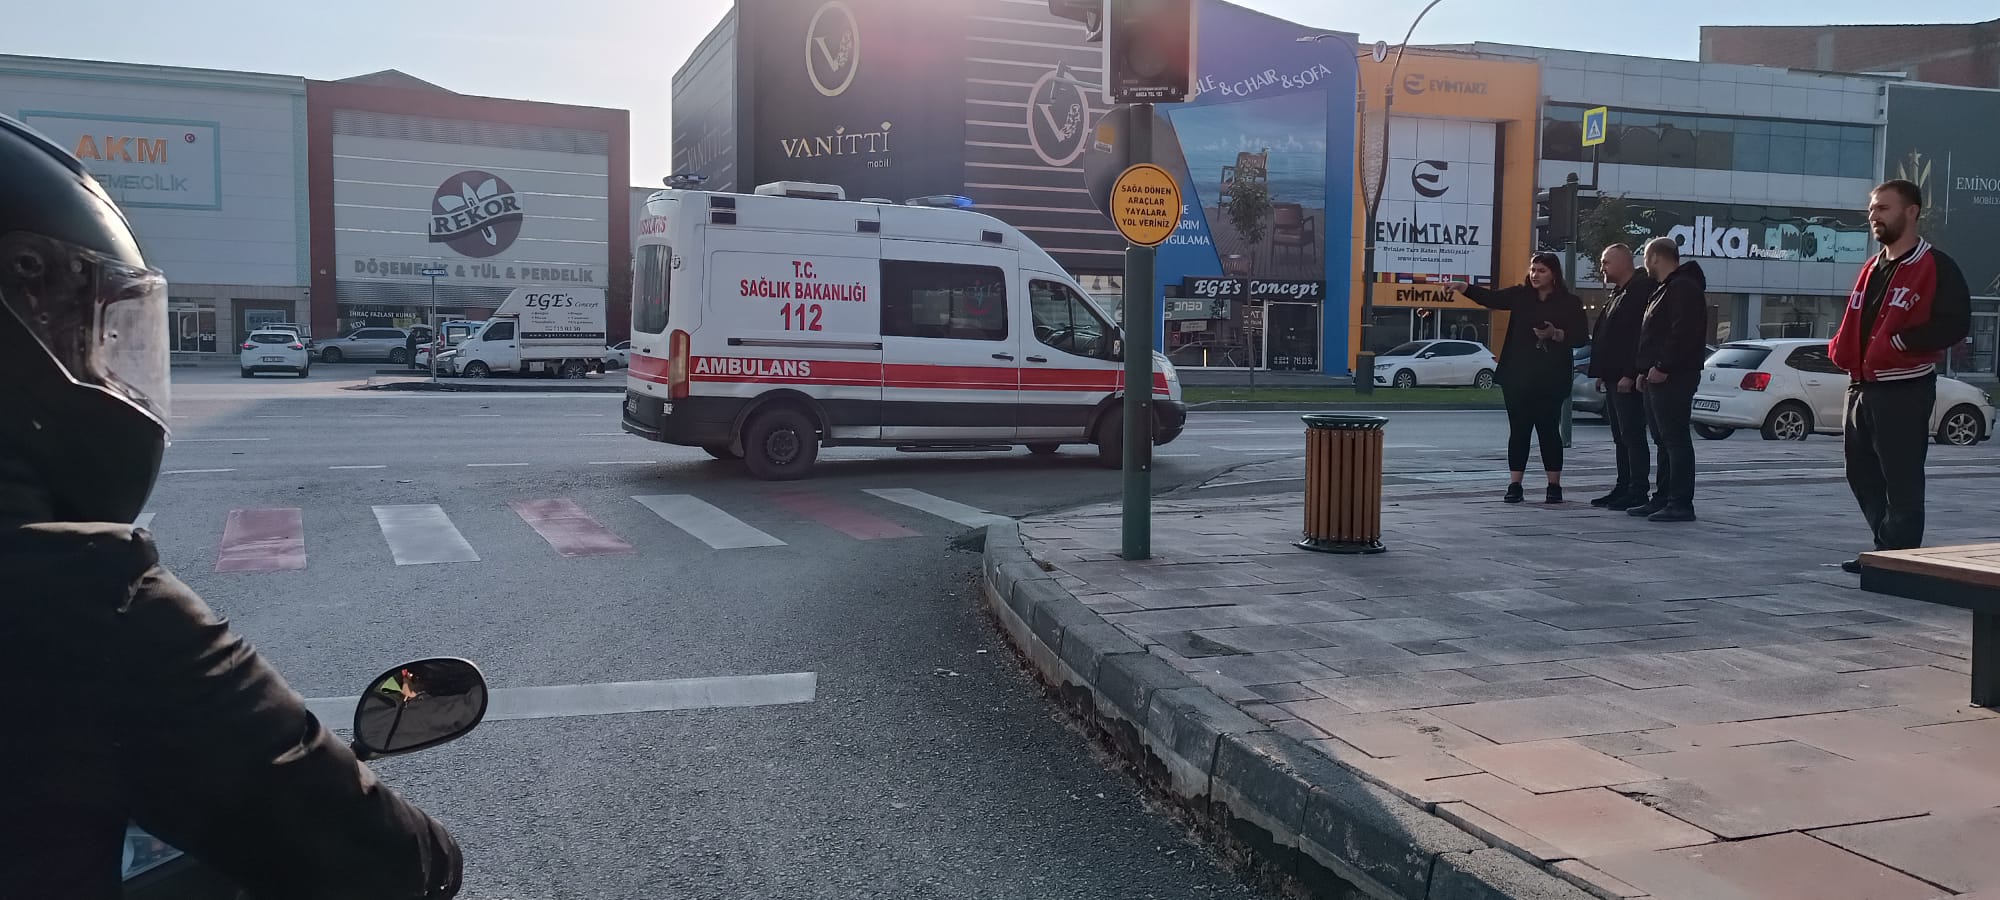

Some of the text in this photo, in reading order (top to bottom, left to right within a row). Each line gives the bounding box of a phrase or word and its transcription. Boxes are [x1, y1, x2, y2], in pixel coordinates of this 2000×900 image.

[1219, 81, 1233, 95] &
[1233, 69, 1280, 97] CHAIR
[1280, 74, 1294, 89] &
[1292, 63, 1332, 89] SOFA
[76, 134, 168, 163] AKM
[1121, 184, 1171, 195] SAĞA DÖNEN
[1128, 197, 1165, 206] ARAÇLAR
[433, 196, 521, 233] REKOR
[1125, 207, 1167, 217] YAYALARA
[1122, 217, 1170, 228] YOL VERİNİZ
[1376, 217, 1479, 245] EVİMTARZ
[1668, 216, 1749, 259] alka
[454, 265, 466, 278] &
[470, 263, 500, 279] TÜL
[505, 267, 516, 280] &
[521, 267, 594, 282] PERDELİK
[792, 260, 817, 279] T.C.
[740, 275, 867, 302] SAĞLIK BAKANLIĞI
[1251, 280, 1320, 299] Concept
[525, 292, 574, 310] EGE's
[780, 302, 823, 331] 112
[695, 357, 811, 377] AMBULANS
